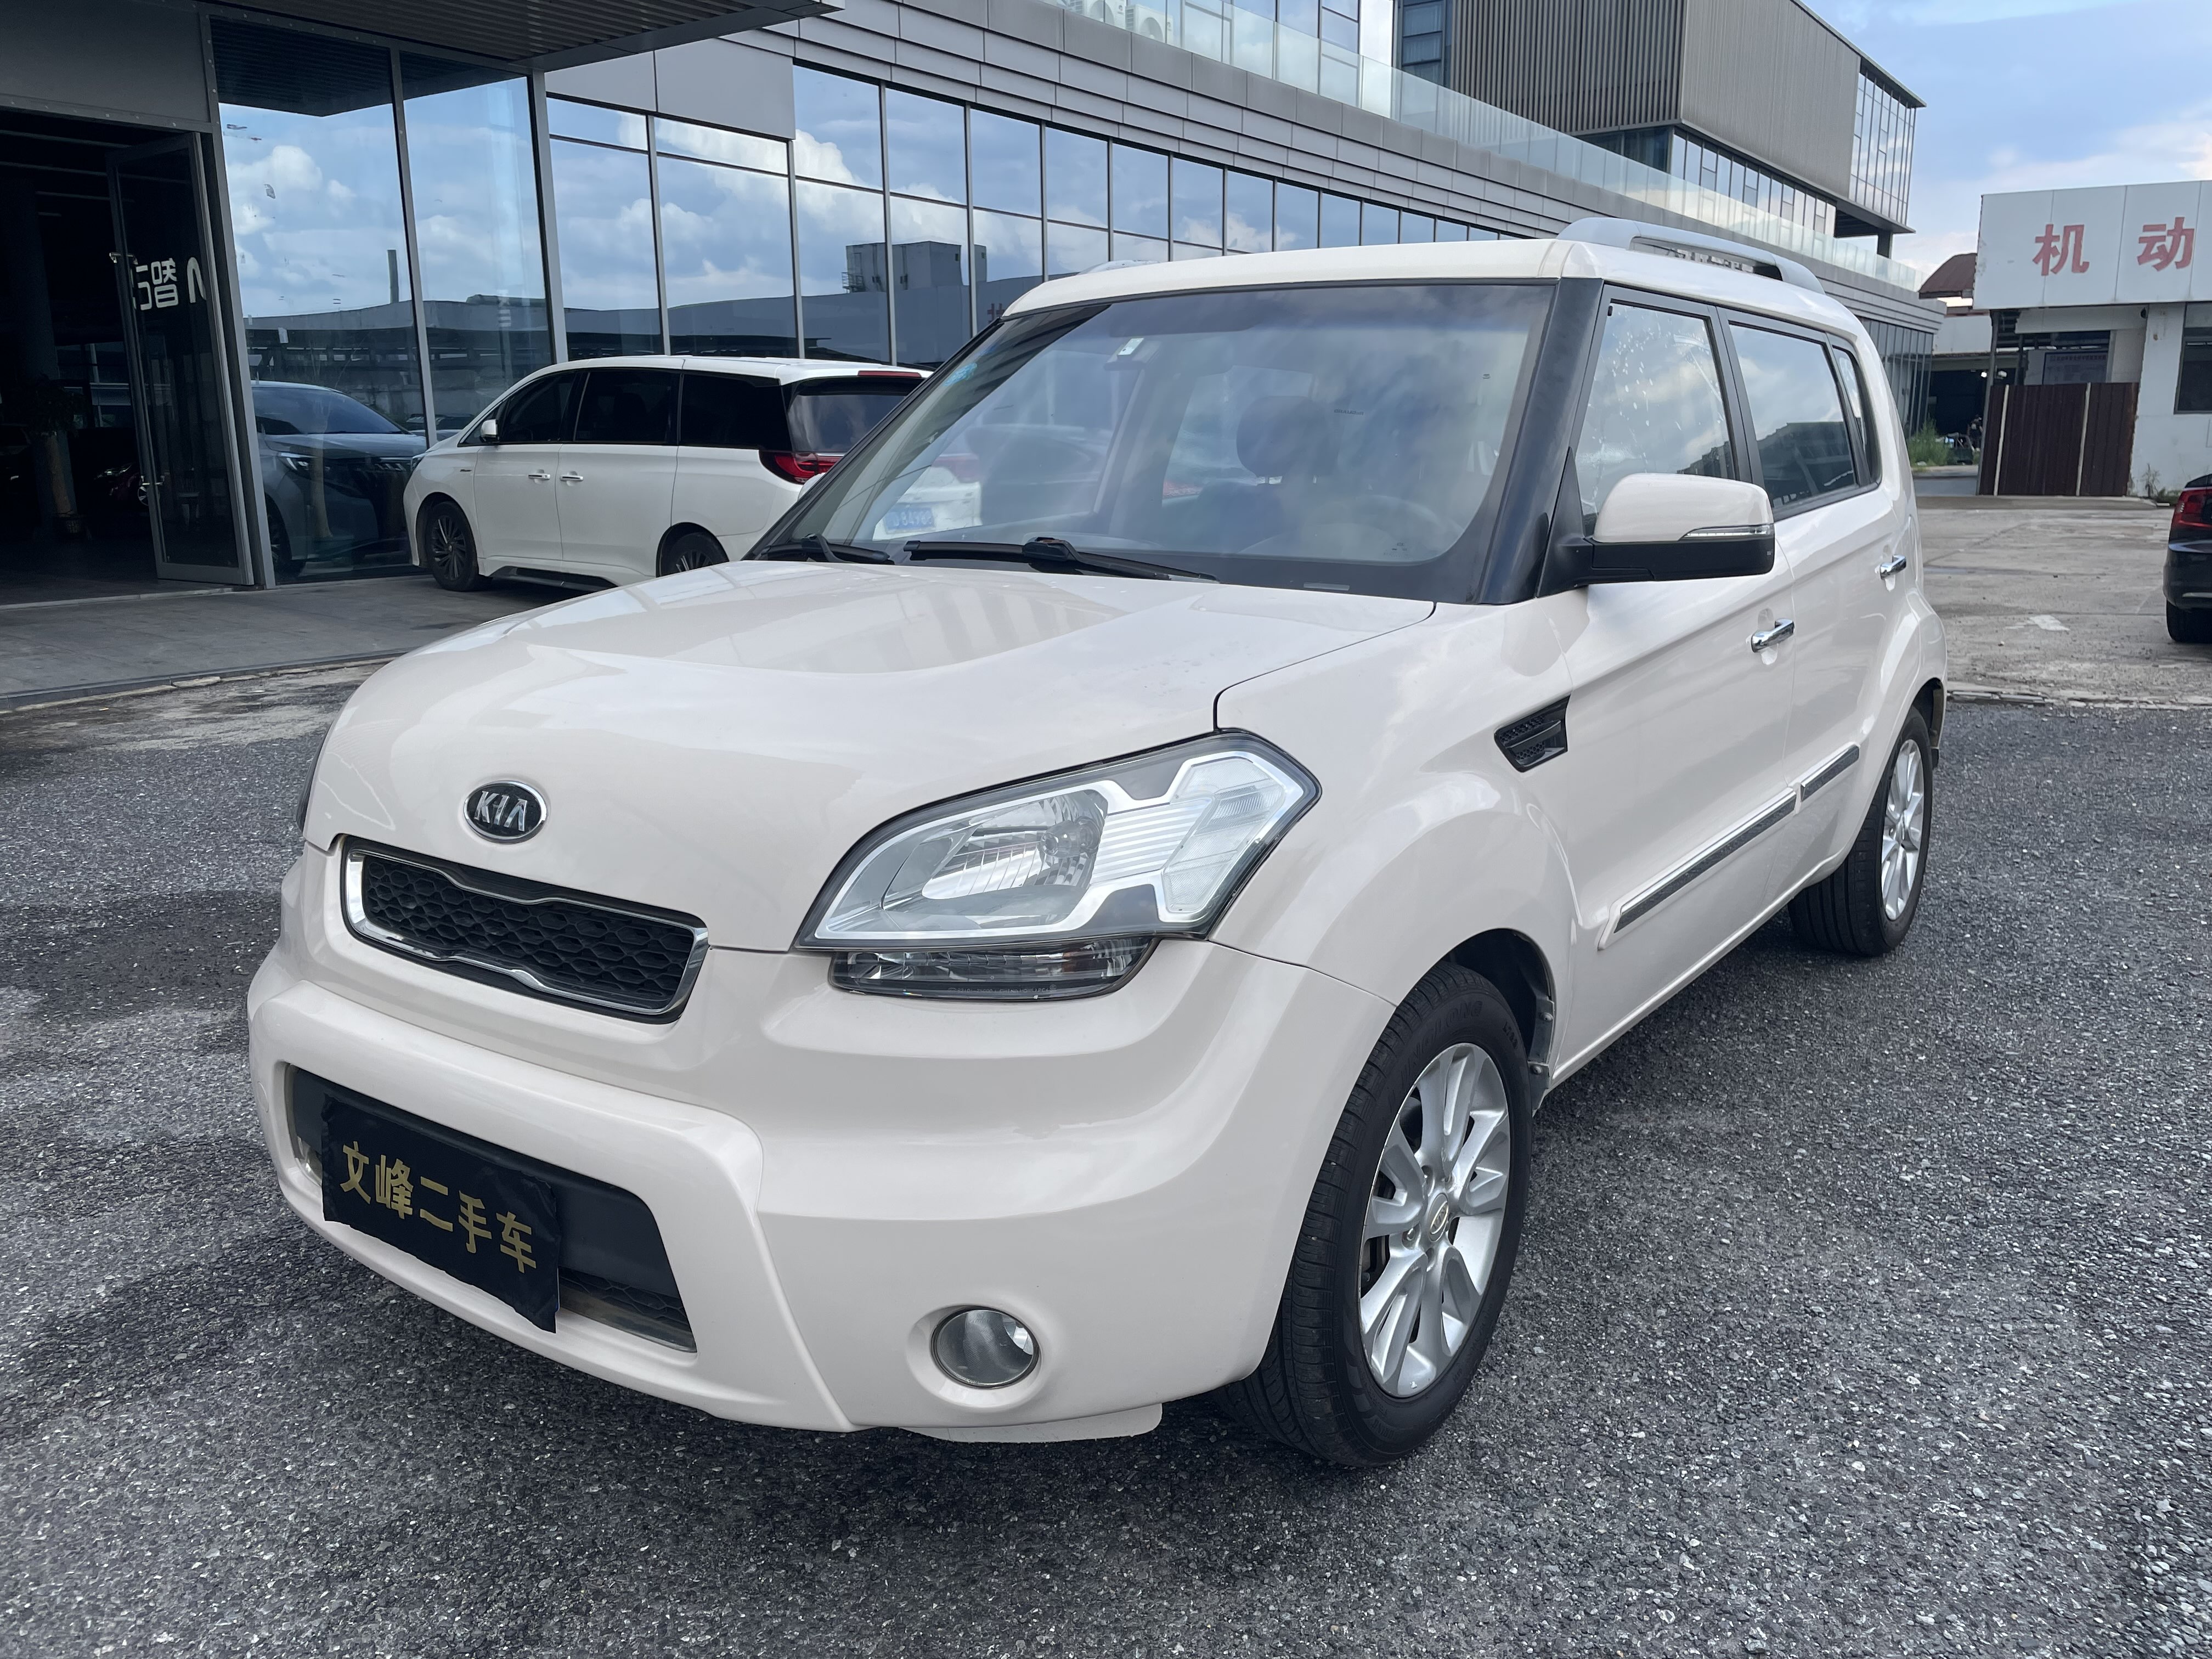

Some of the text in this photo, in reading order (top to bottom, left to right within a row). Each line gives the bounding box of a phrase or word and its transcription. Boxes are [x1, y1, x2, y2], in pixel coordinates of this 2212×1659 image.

[2033, 217, 2195, 276] 机动
[474, 791, 527, 832] KIA
[340, 1141, 537, 1273] 文峰二手车
